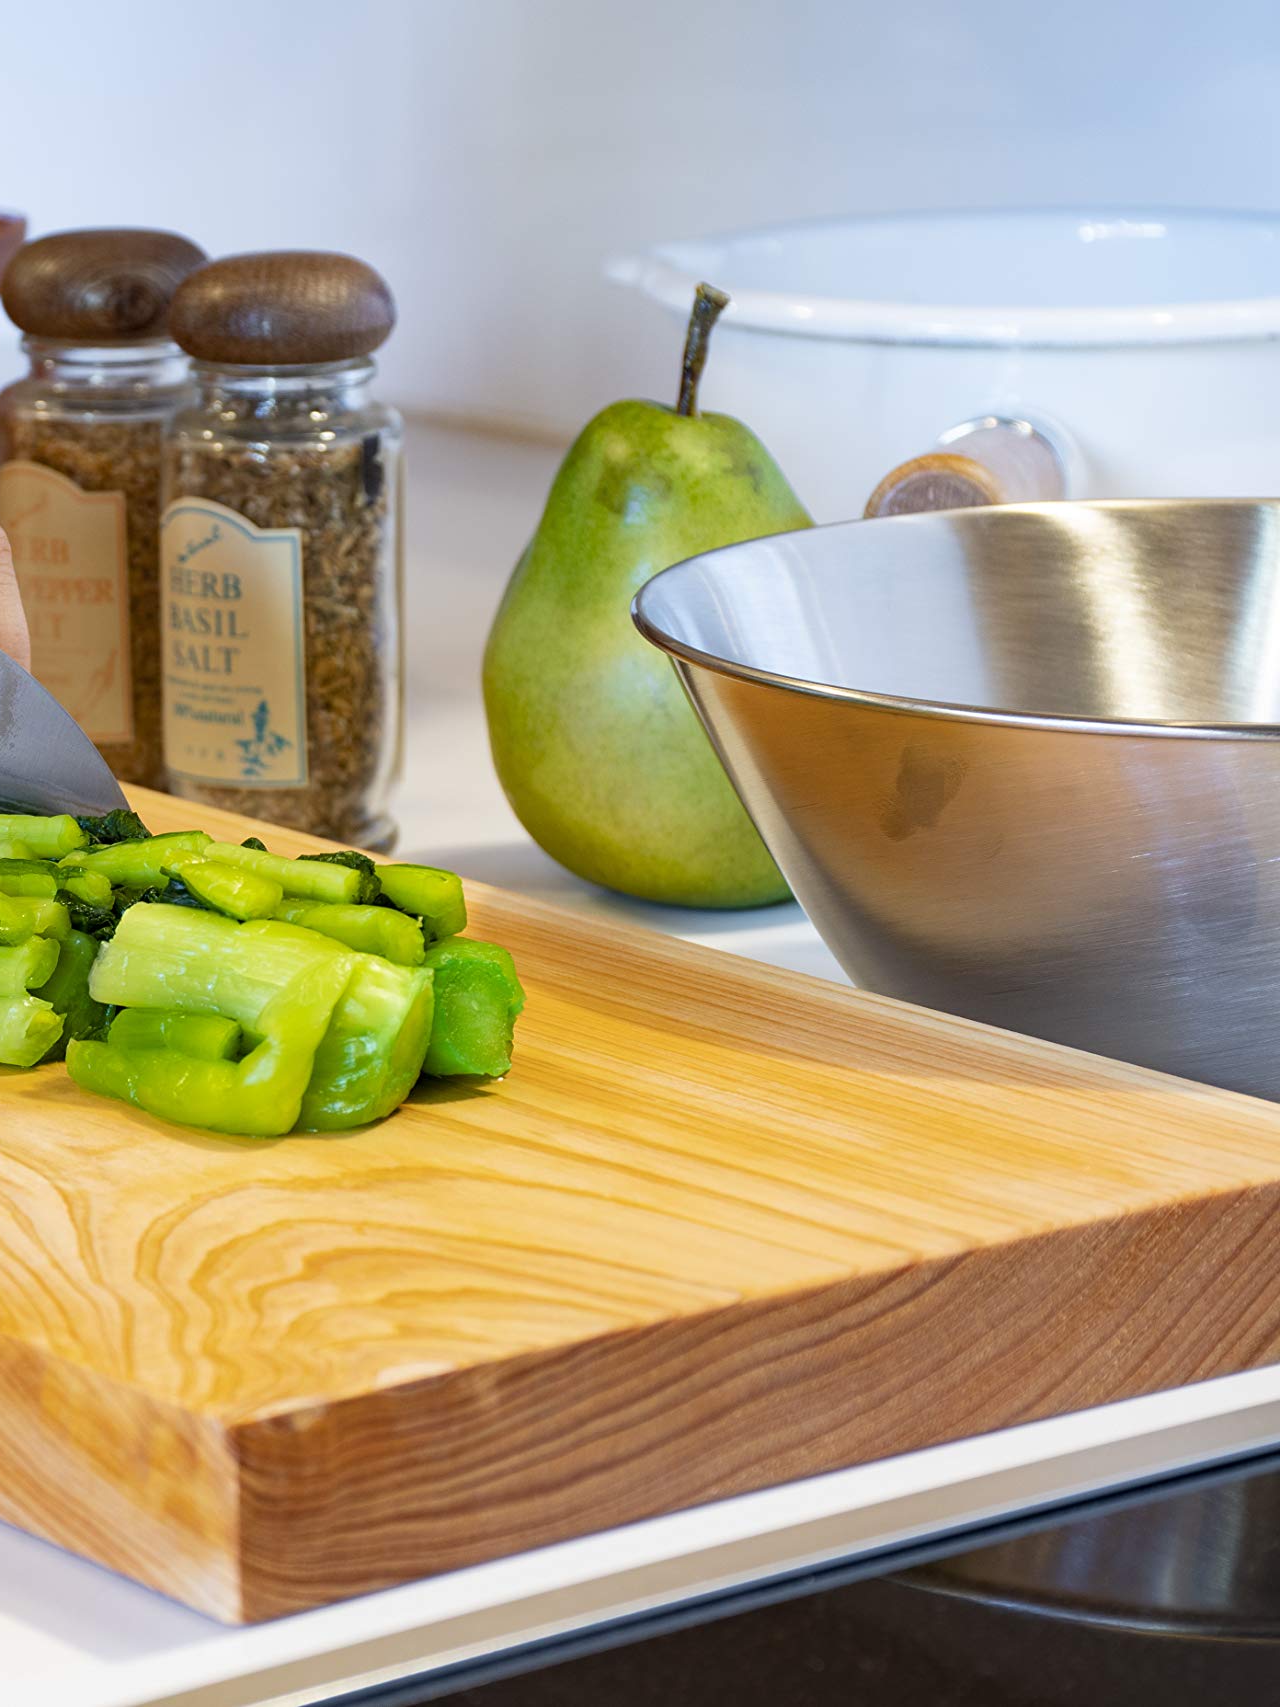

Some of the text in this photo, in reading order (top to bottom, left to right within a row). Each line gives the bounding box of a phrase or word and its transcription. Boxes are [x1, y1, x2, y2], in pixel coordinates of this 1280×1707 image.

[170, 566, 242, 600] HERB
[169, 602, 250, 639] BASIL
[172, 640, 241, 676] SALT
